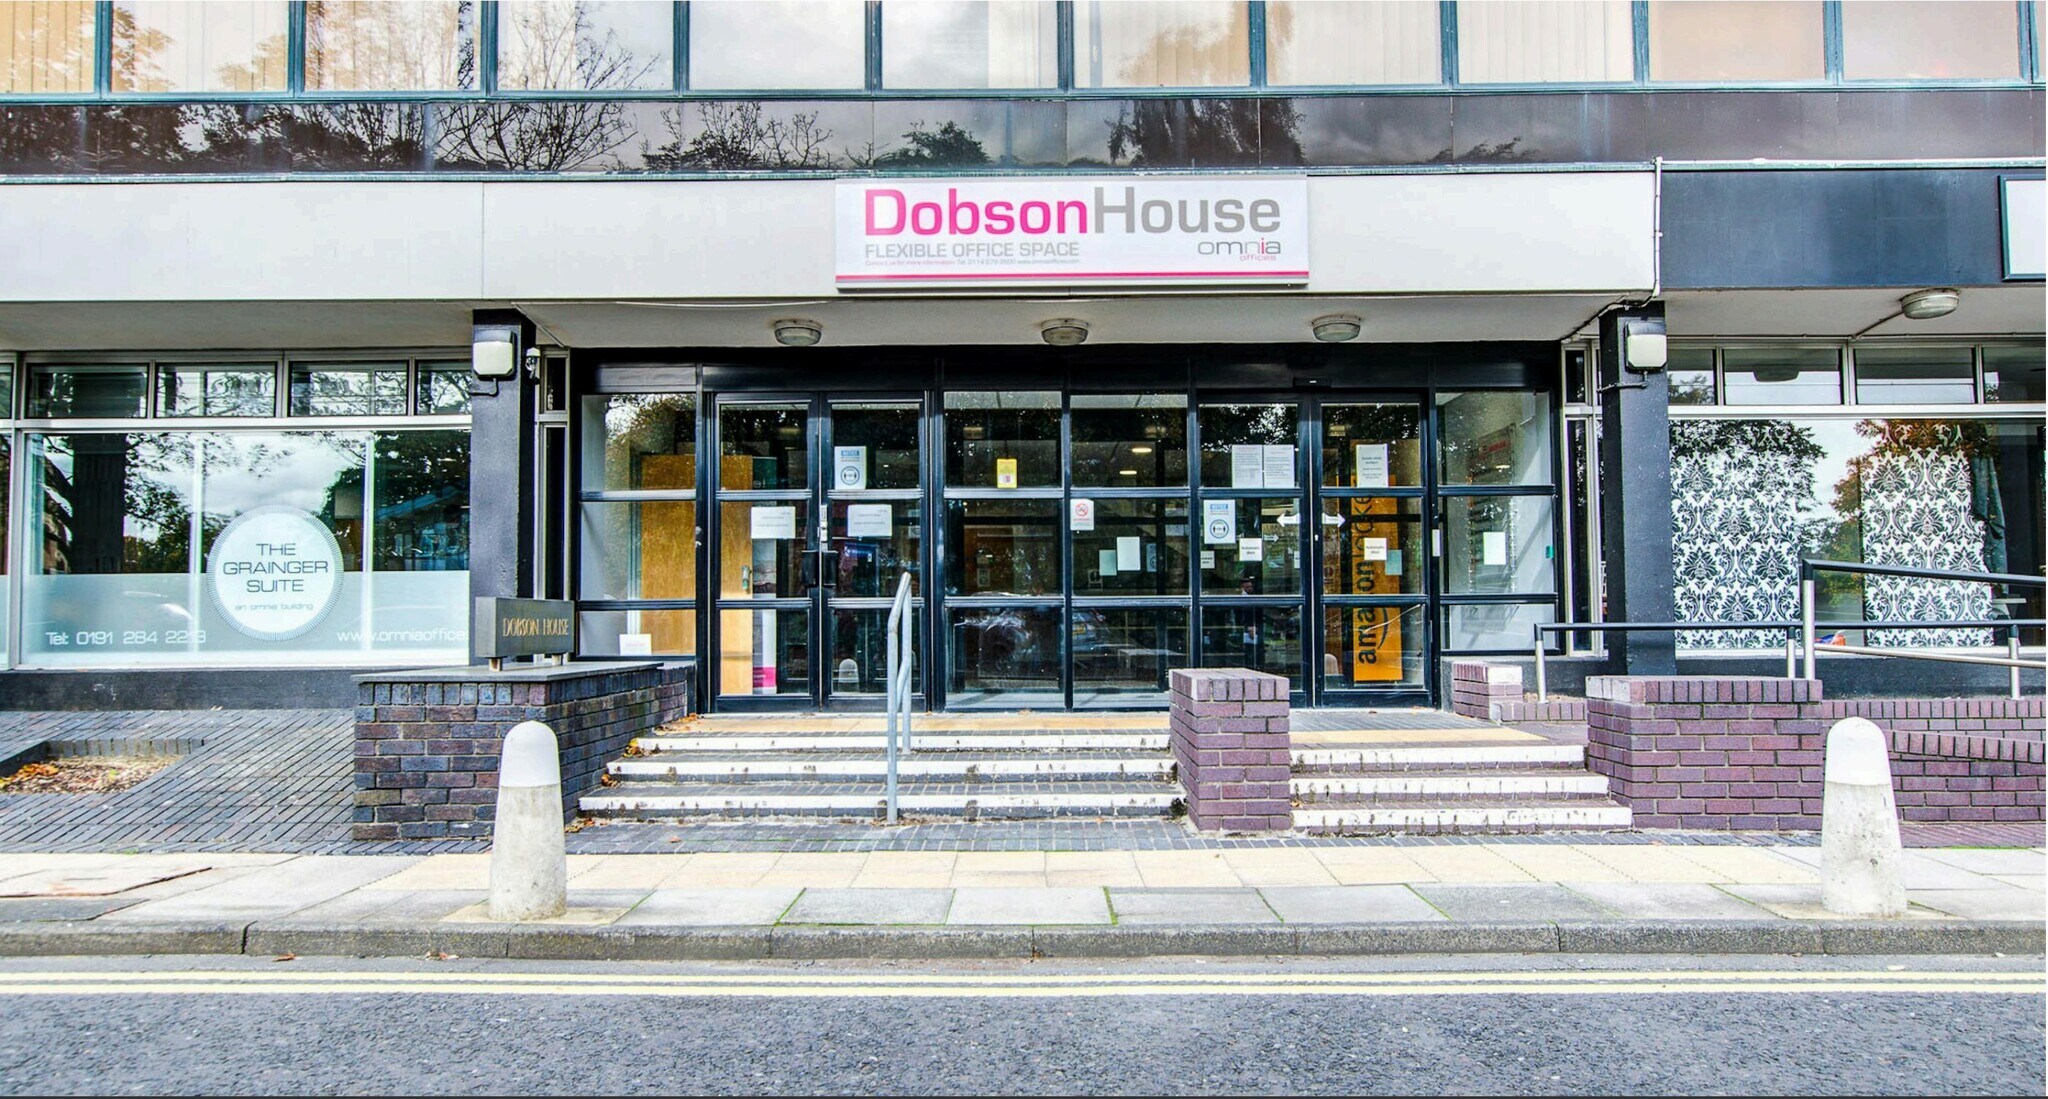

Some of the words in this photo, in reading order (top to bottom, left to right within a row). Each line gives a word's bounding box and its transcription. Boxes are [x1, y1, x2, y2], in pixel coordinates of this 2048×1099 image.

[865, 243, 947, 259] FLEXIBLE
[952, 242, 1014, 257] OFFICE
[1019, 242, 1079, 256] SPACE
[1197, 237, 1281, 255] omnia
[256, 543, 296, 556] THE
[223, 561, 328, 575] GRAINGER
[246, 579, 304, 592] SUITE
[280, 602, 314, 611] building
[502, 618, 539, 637] DOBSON
[543, 618, 569, 636] HOUSE
[76, 631, 113, 645] 0191
[123, 631, 158, 645] 284
